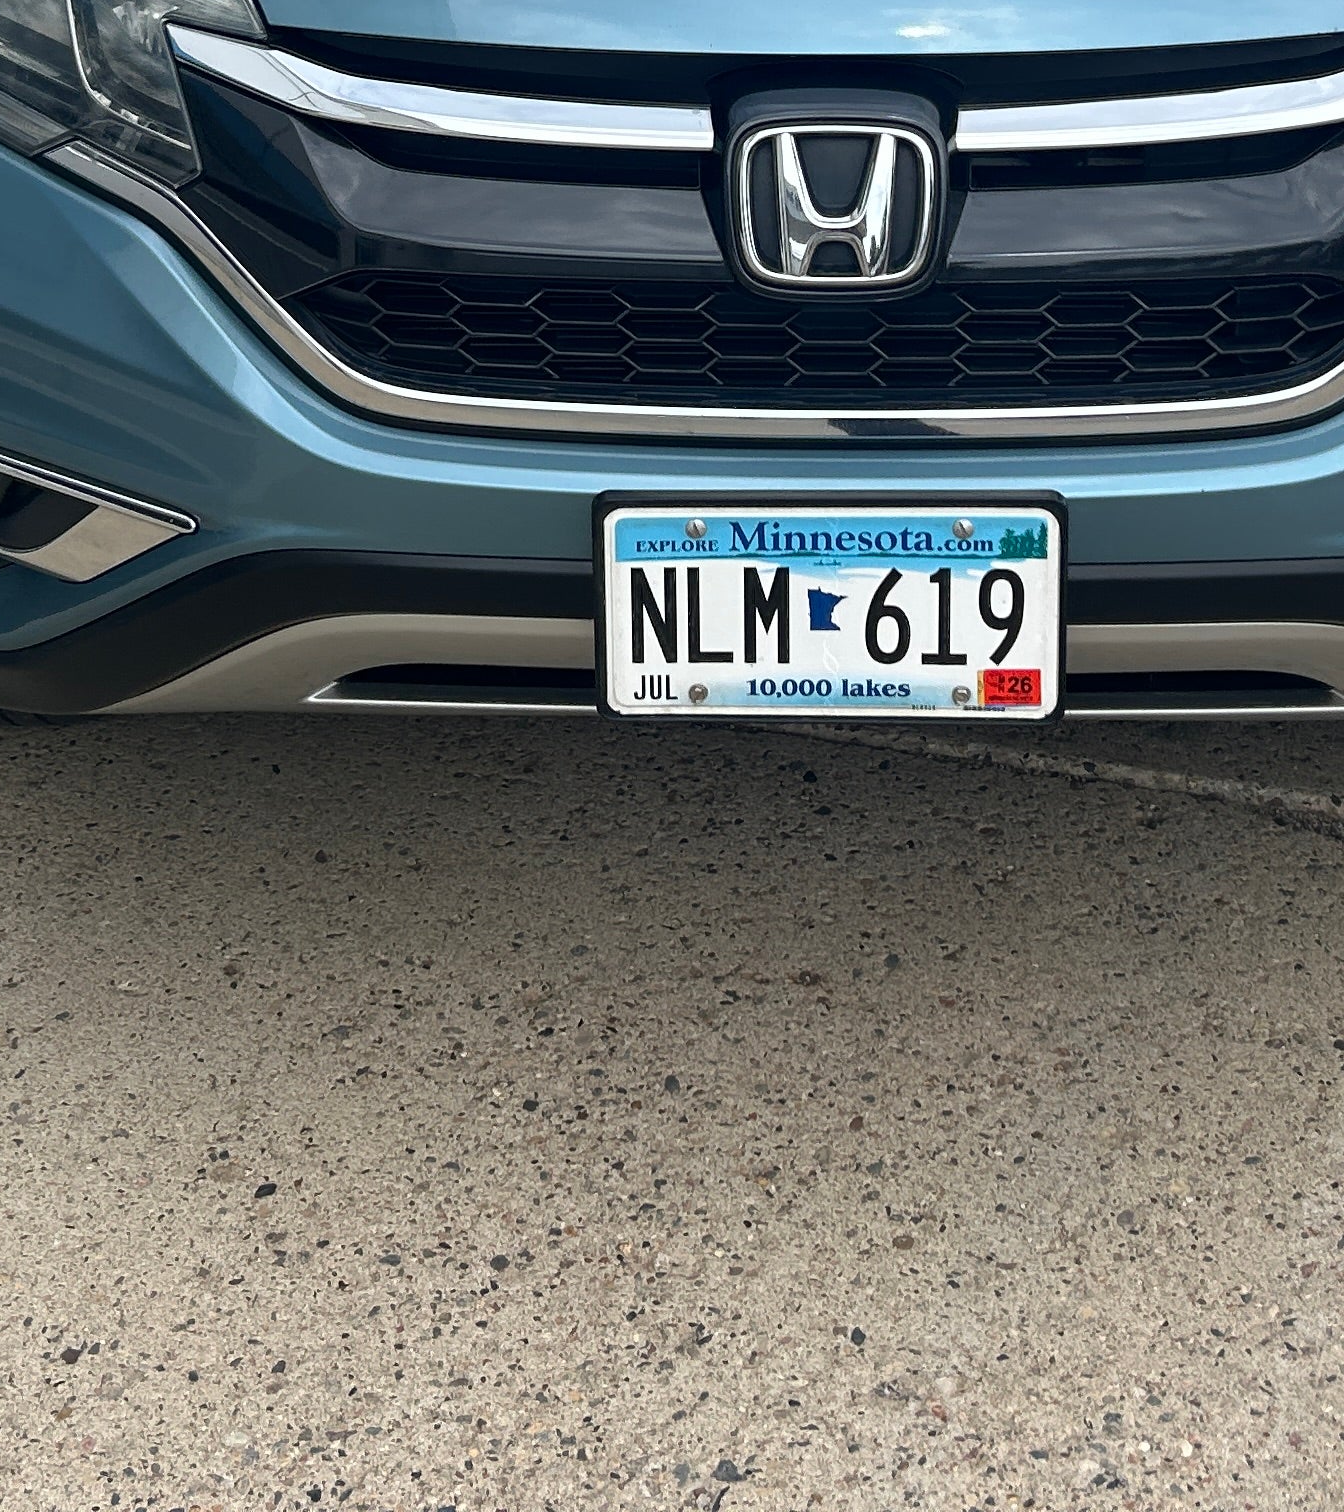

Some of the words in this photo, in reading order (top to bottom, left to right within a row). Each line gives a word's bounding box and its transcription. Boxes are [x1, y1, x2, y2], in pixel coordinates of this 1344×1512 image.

[636, 539, 720, 553] EXPLORE
[630, 566, 790, 664] NLM
[864, 567, 1025, 666] 619
[633, 674, 678, 701] JUL
[745, 678, 833, 699] 10,000
[841, 678, 911, 697] lakes
[1007, 676, 1032, 694] 26
